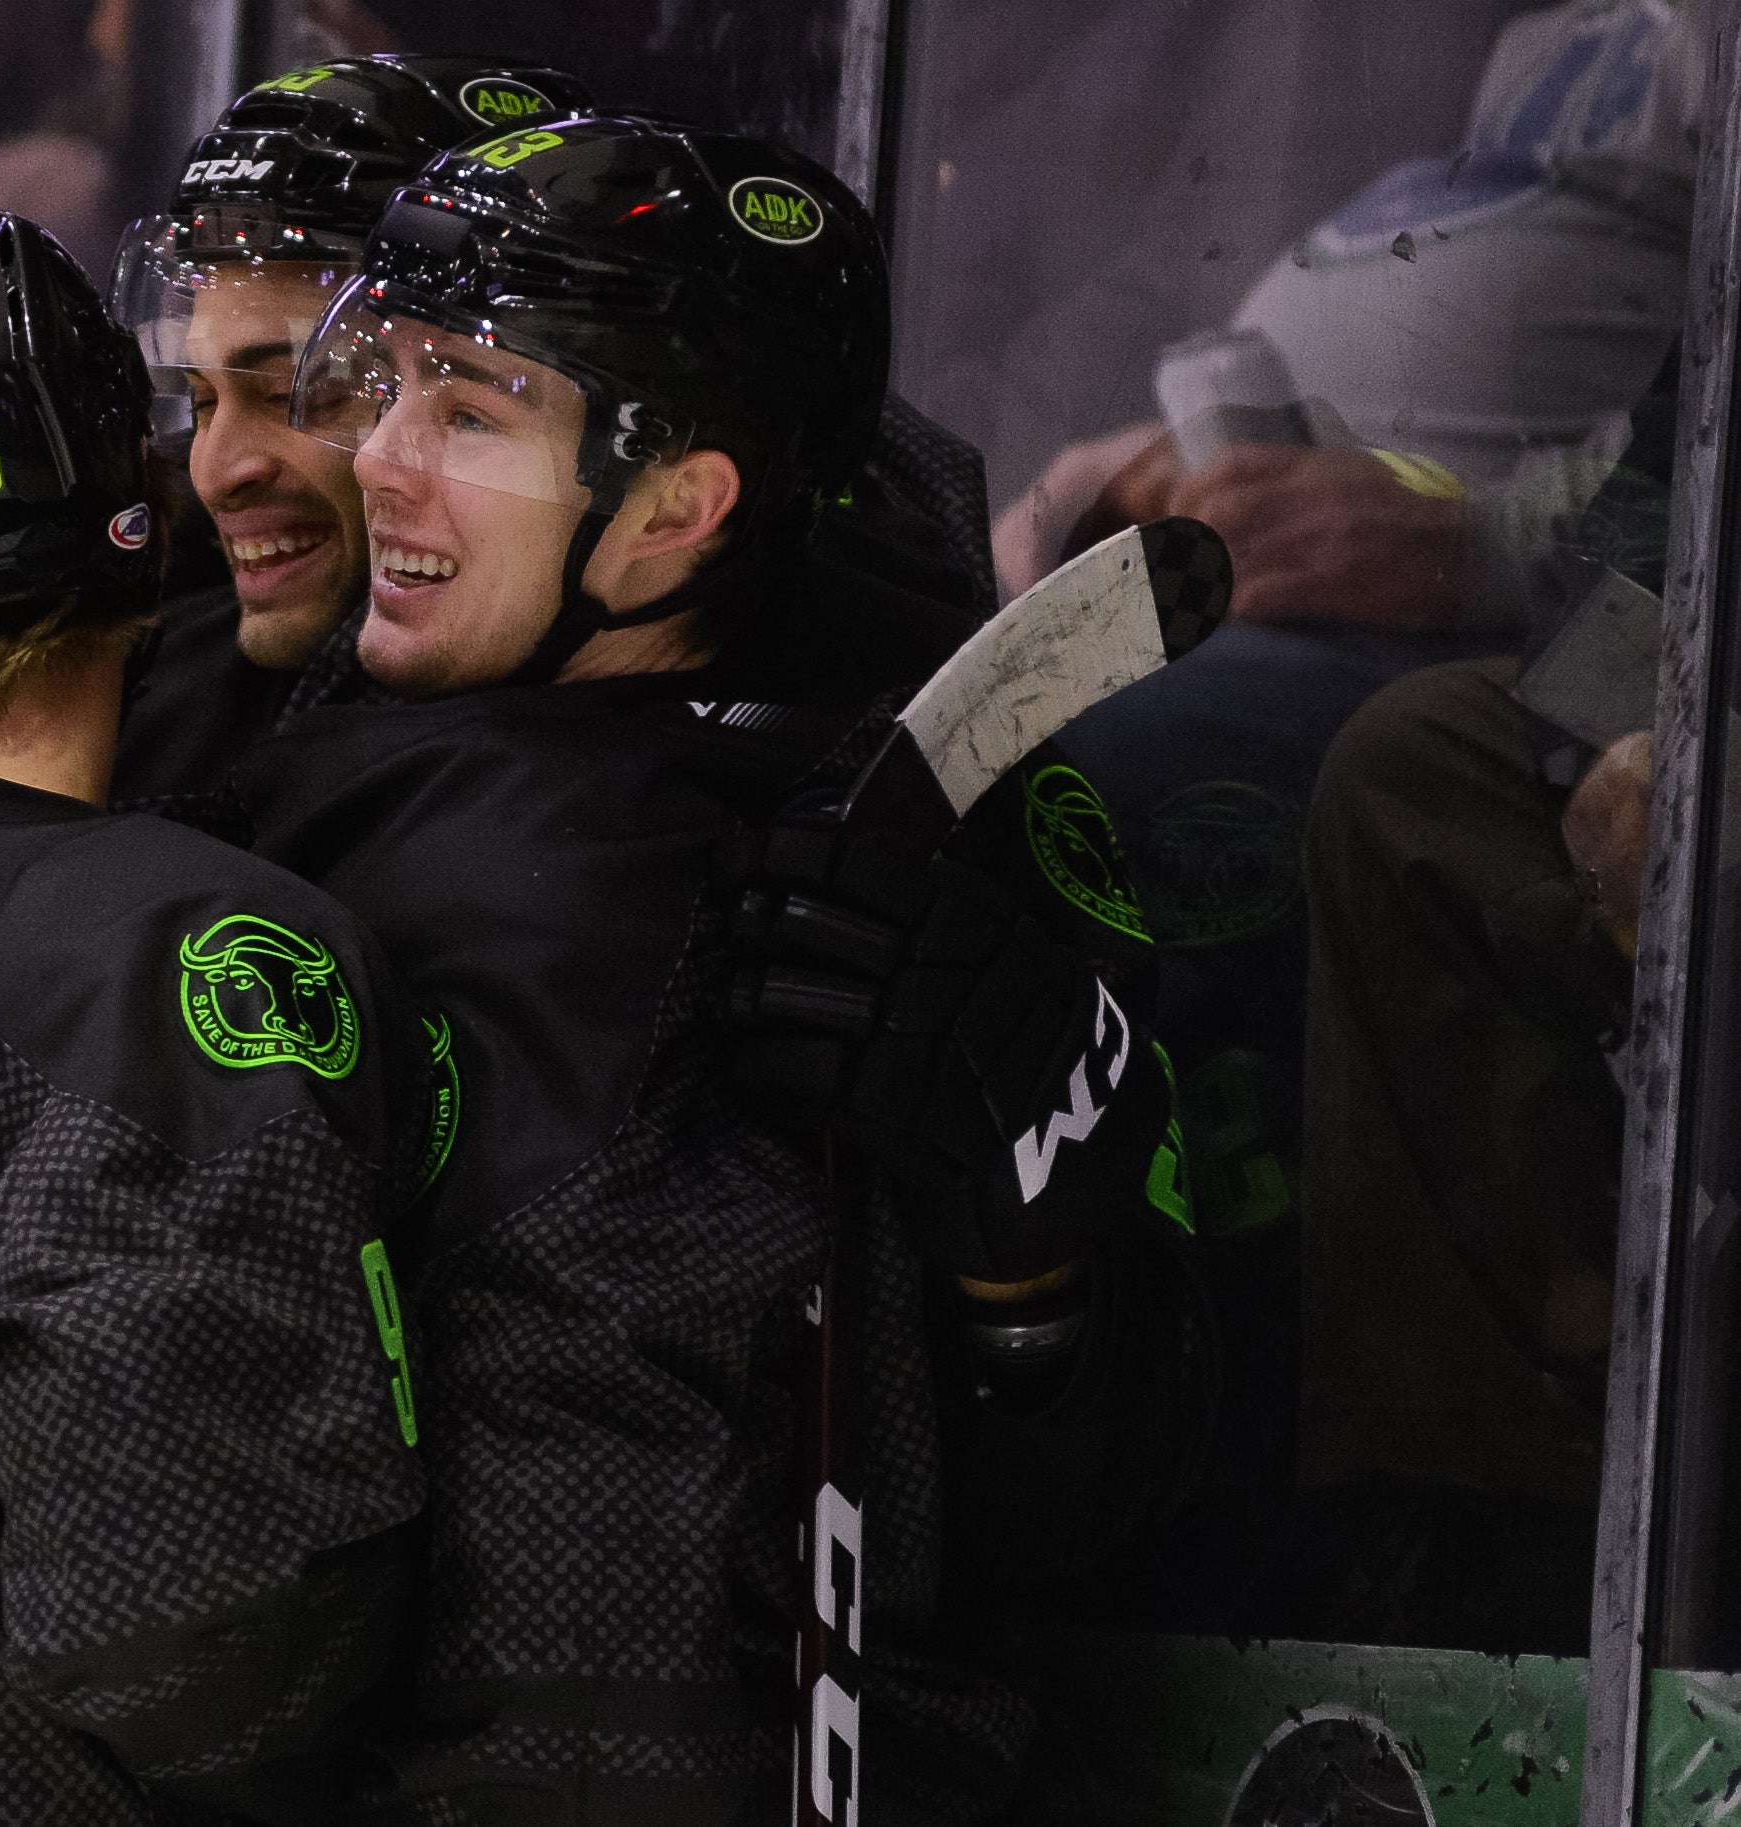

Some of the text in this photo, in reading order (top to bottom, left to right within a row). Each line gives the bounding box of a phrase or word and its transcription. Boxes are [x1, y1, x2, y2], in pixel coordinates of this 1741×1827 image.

[182, 158, 275, 184] CCM
[744, 191, 813, 228] ADK
[192, 993, 222, 1044] SAVE
[219, 1037, 241, 1057] OF
[241, 1041, 277, 1058] THE
[361, 1239, 418, 1448] 9
